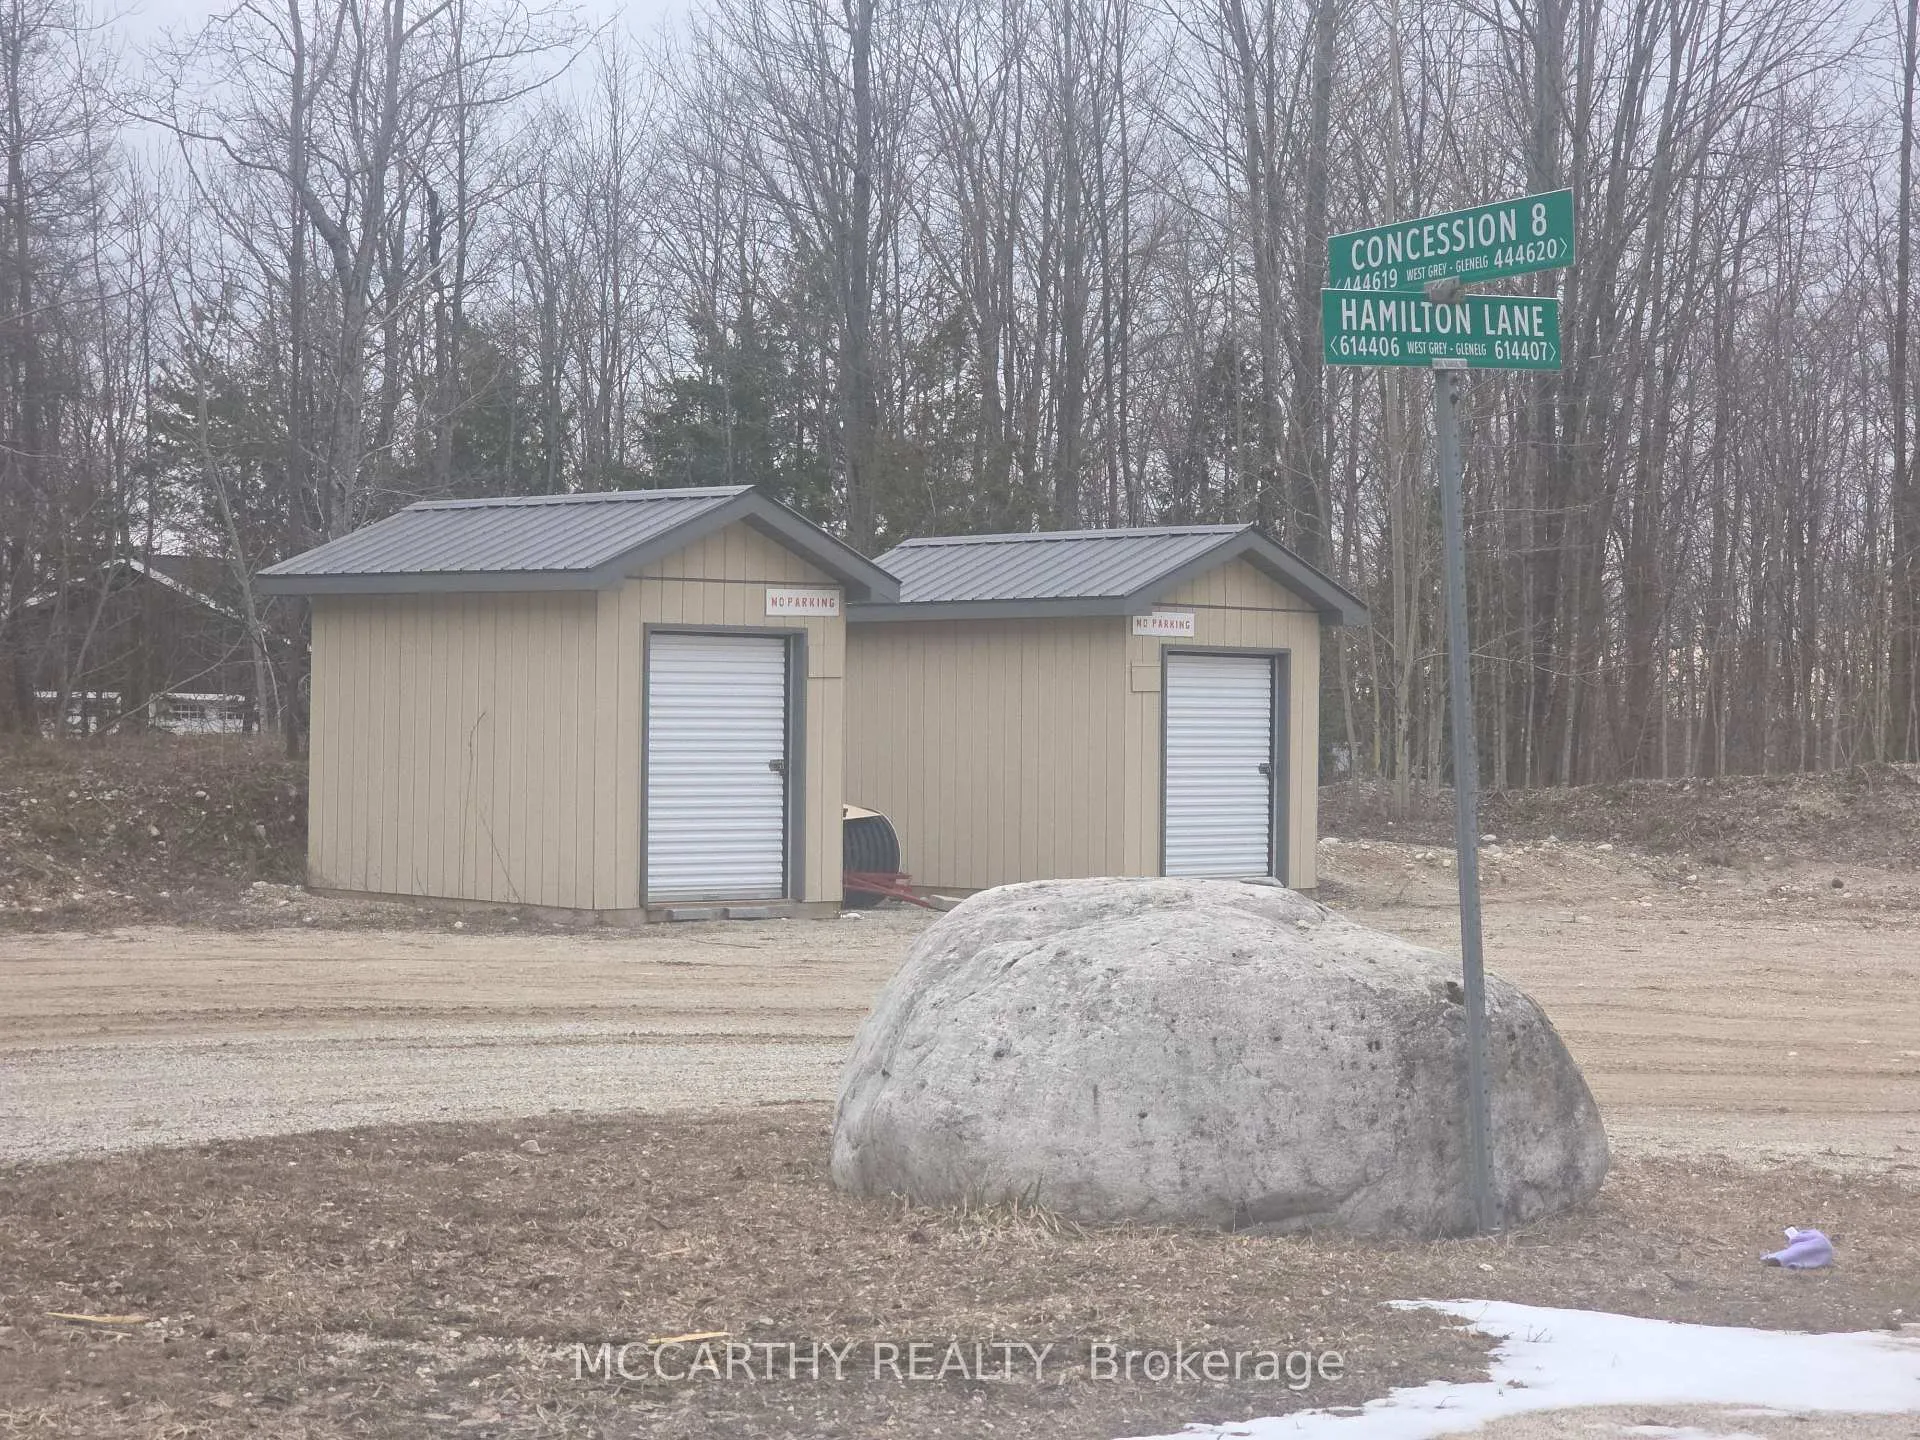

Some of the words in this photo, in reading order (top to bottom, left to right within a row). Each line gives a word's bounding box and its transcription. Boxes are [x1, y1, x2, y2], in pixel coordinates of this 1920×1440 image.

[1351, 208, 1516, 270] CONCESSION
[1531, 203, 1547, 236] 8
[1344, 268, 1398, 290] 444619
[1406, 267, 1425, 281] WEST
[1428, 263, 1447, 277] GREY
[1456, 255, 1488, 273] GLENELG
[1494, 238, 1557, 267] 444620
[1341, 298, 1471, 334] HAMILTON
[1484, 304, 1545, 337] LANE
[1340, 335, 1400, 357] 614406
[1407, 341, 1425, 354] WEST
[1428, 342, 1447, 355] GREY
[1456, 343, 1487, 356] GLENELG
[1495, 340, 1547, 361] 614407
[771, 597, 785, 608] NO
[787, 597, 835, 608] PARKING
[1136, 618, 1149, 628] NO
[1152, 618, 1190, 630] PARKING
